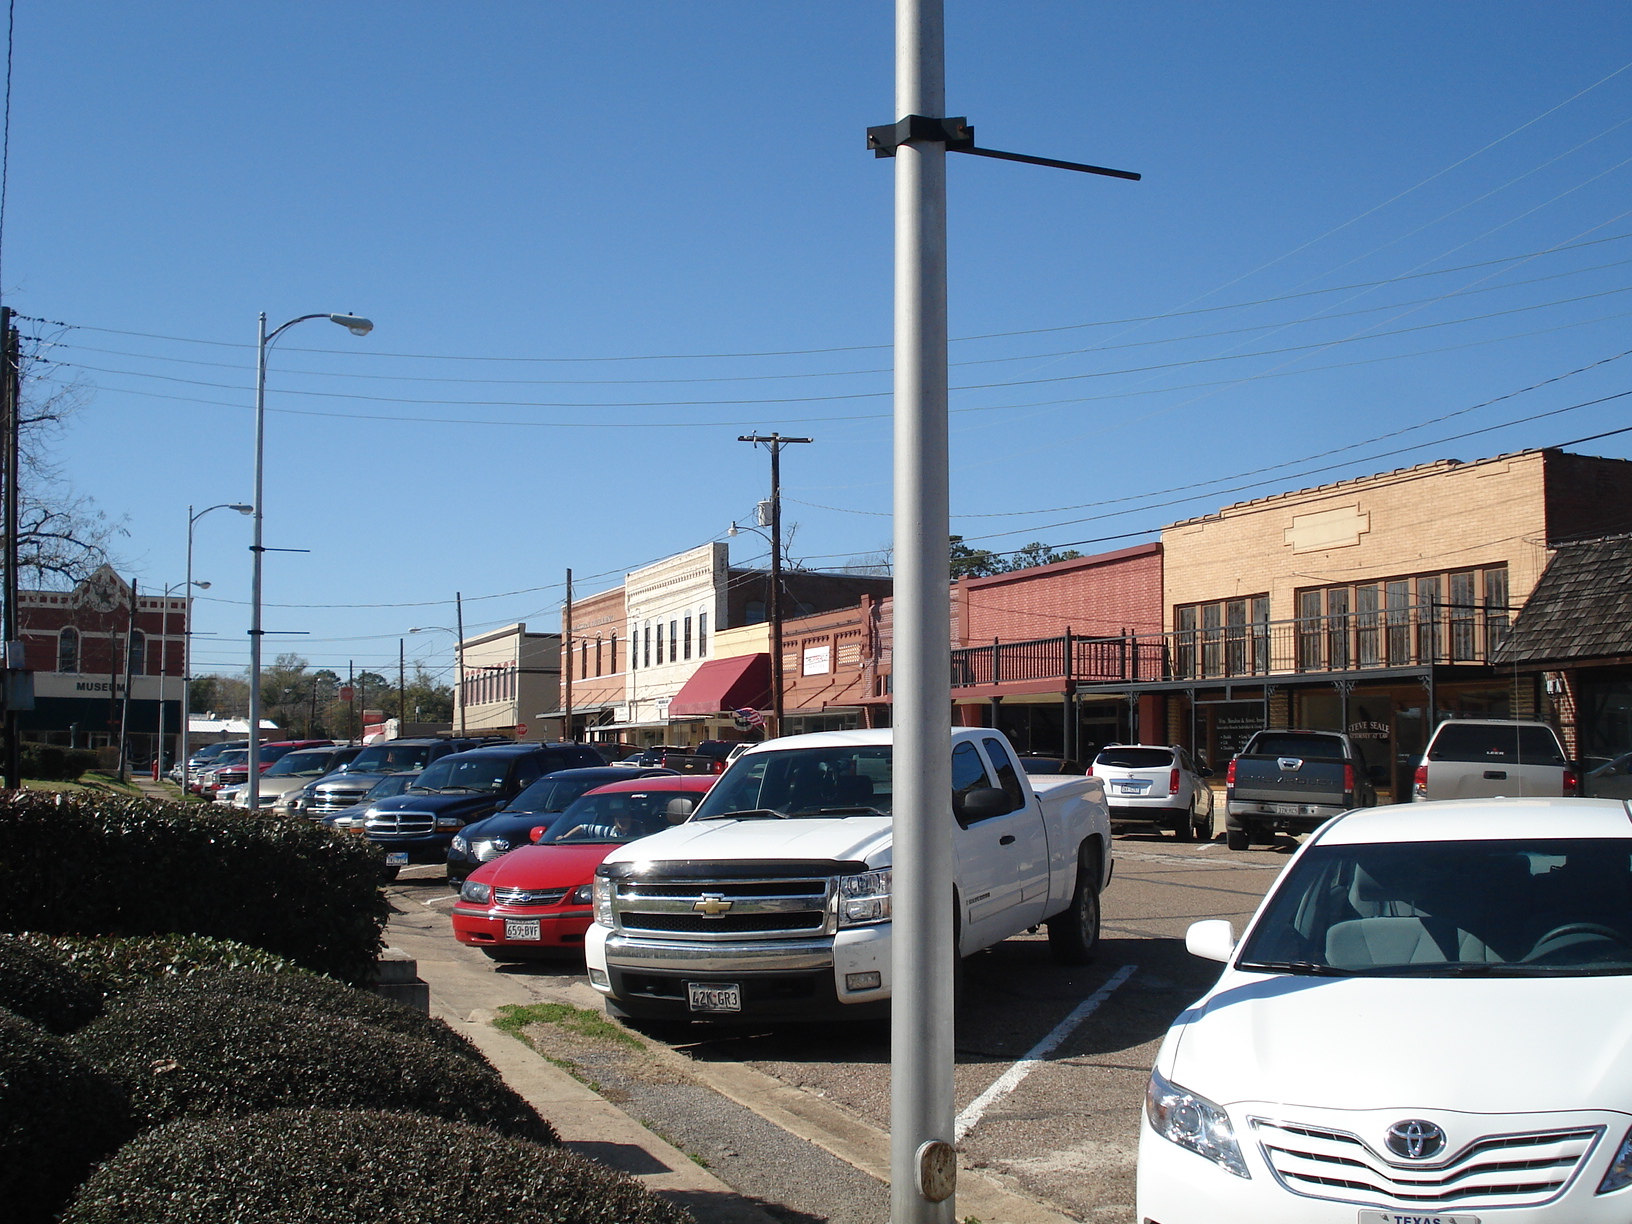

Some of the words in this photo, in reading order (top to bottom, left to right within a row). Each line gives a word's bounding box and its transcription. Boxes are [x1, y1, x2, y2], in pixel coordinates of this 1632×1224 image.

[76, 682, 126, 692] MUSEM
[1348, 721, 1368, 732] STEVE
[1370, 721, 1390, 733] SEALE
[507, 925, 522, 936] 659
[524, 925, 538, 936] BVF
[692, 991, 713, 1005] 42K
[717, 991, 738, 1007] GR3
[1394, 1215, 1441, 1224] TEXAS
